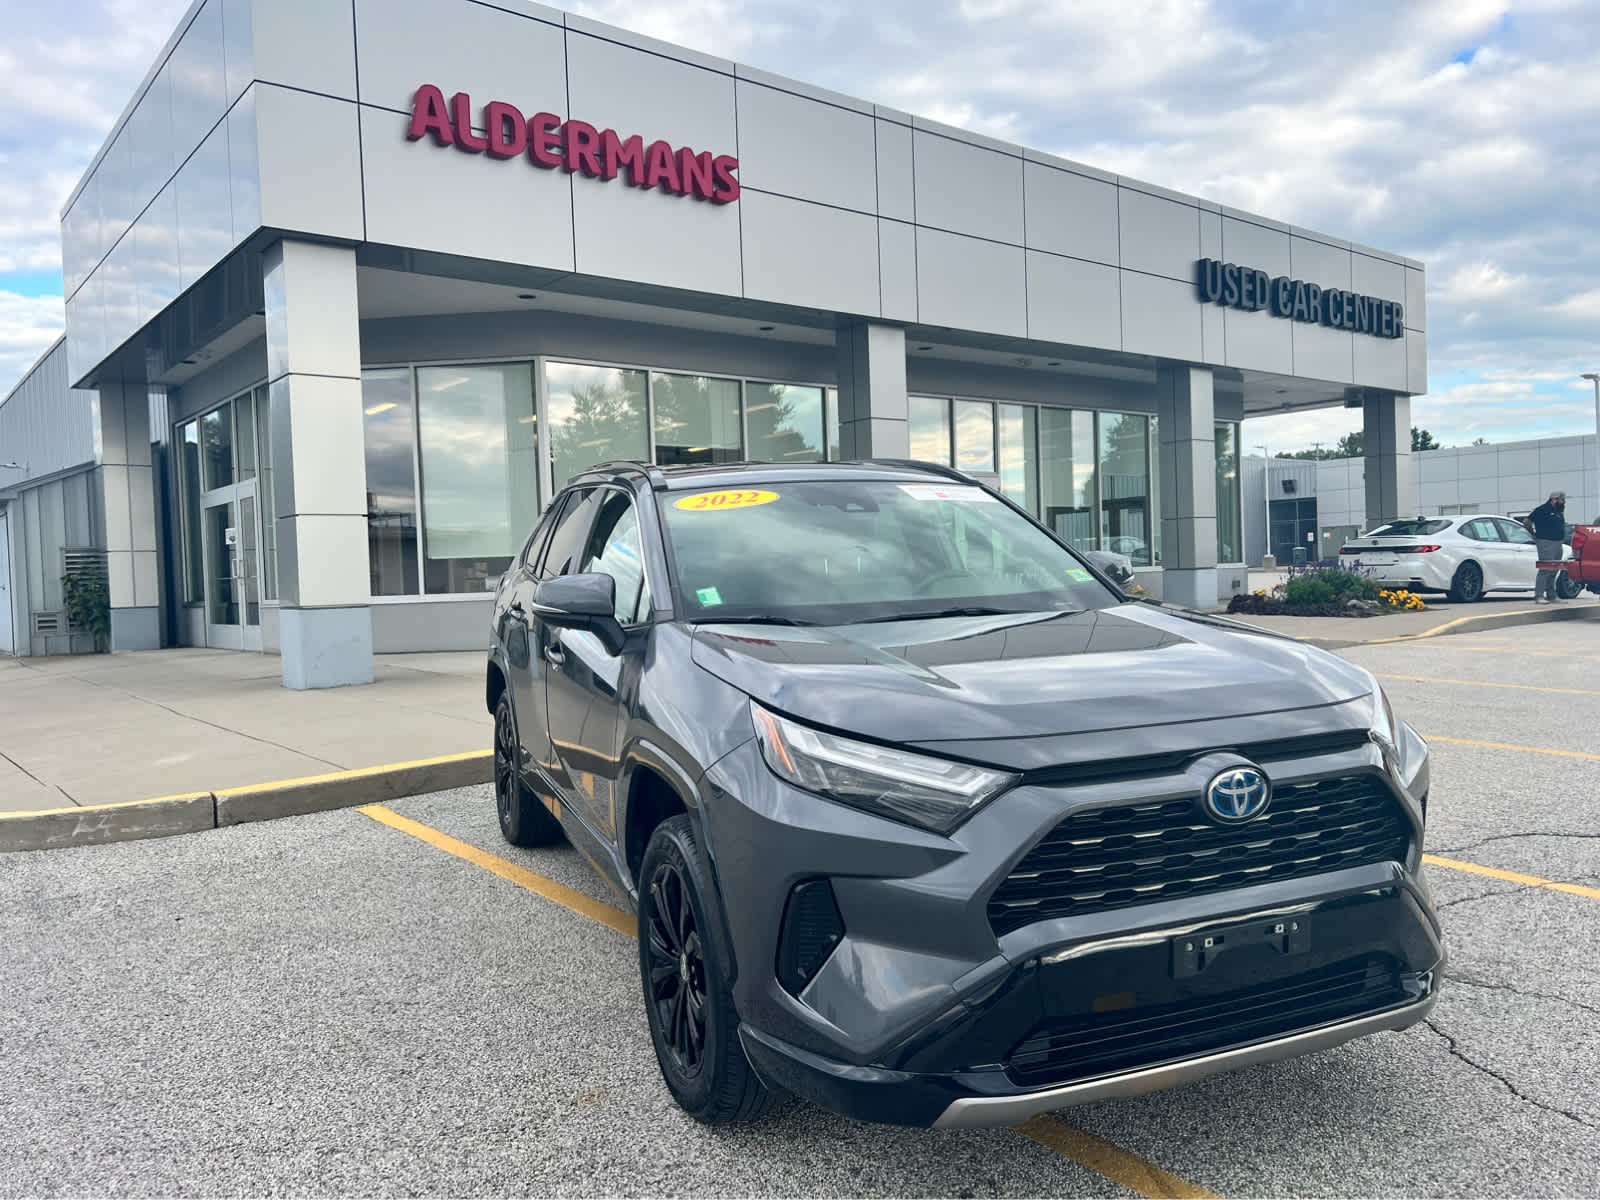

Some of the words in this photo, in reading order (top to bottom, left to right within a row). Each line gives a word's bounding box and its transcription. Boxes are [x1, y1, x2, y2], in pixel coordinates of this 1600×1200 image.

[406, 84, 740, 204] ALDERMANS
[1197, 258, 1271, 311] USED
[1272, 276, 1322, 323] CAR
[1323, 288, 1404, 339] CENTER
[691, 491, 760, 509] 2022
